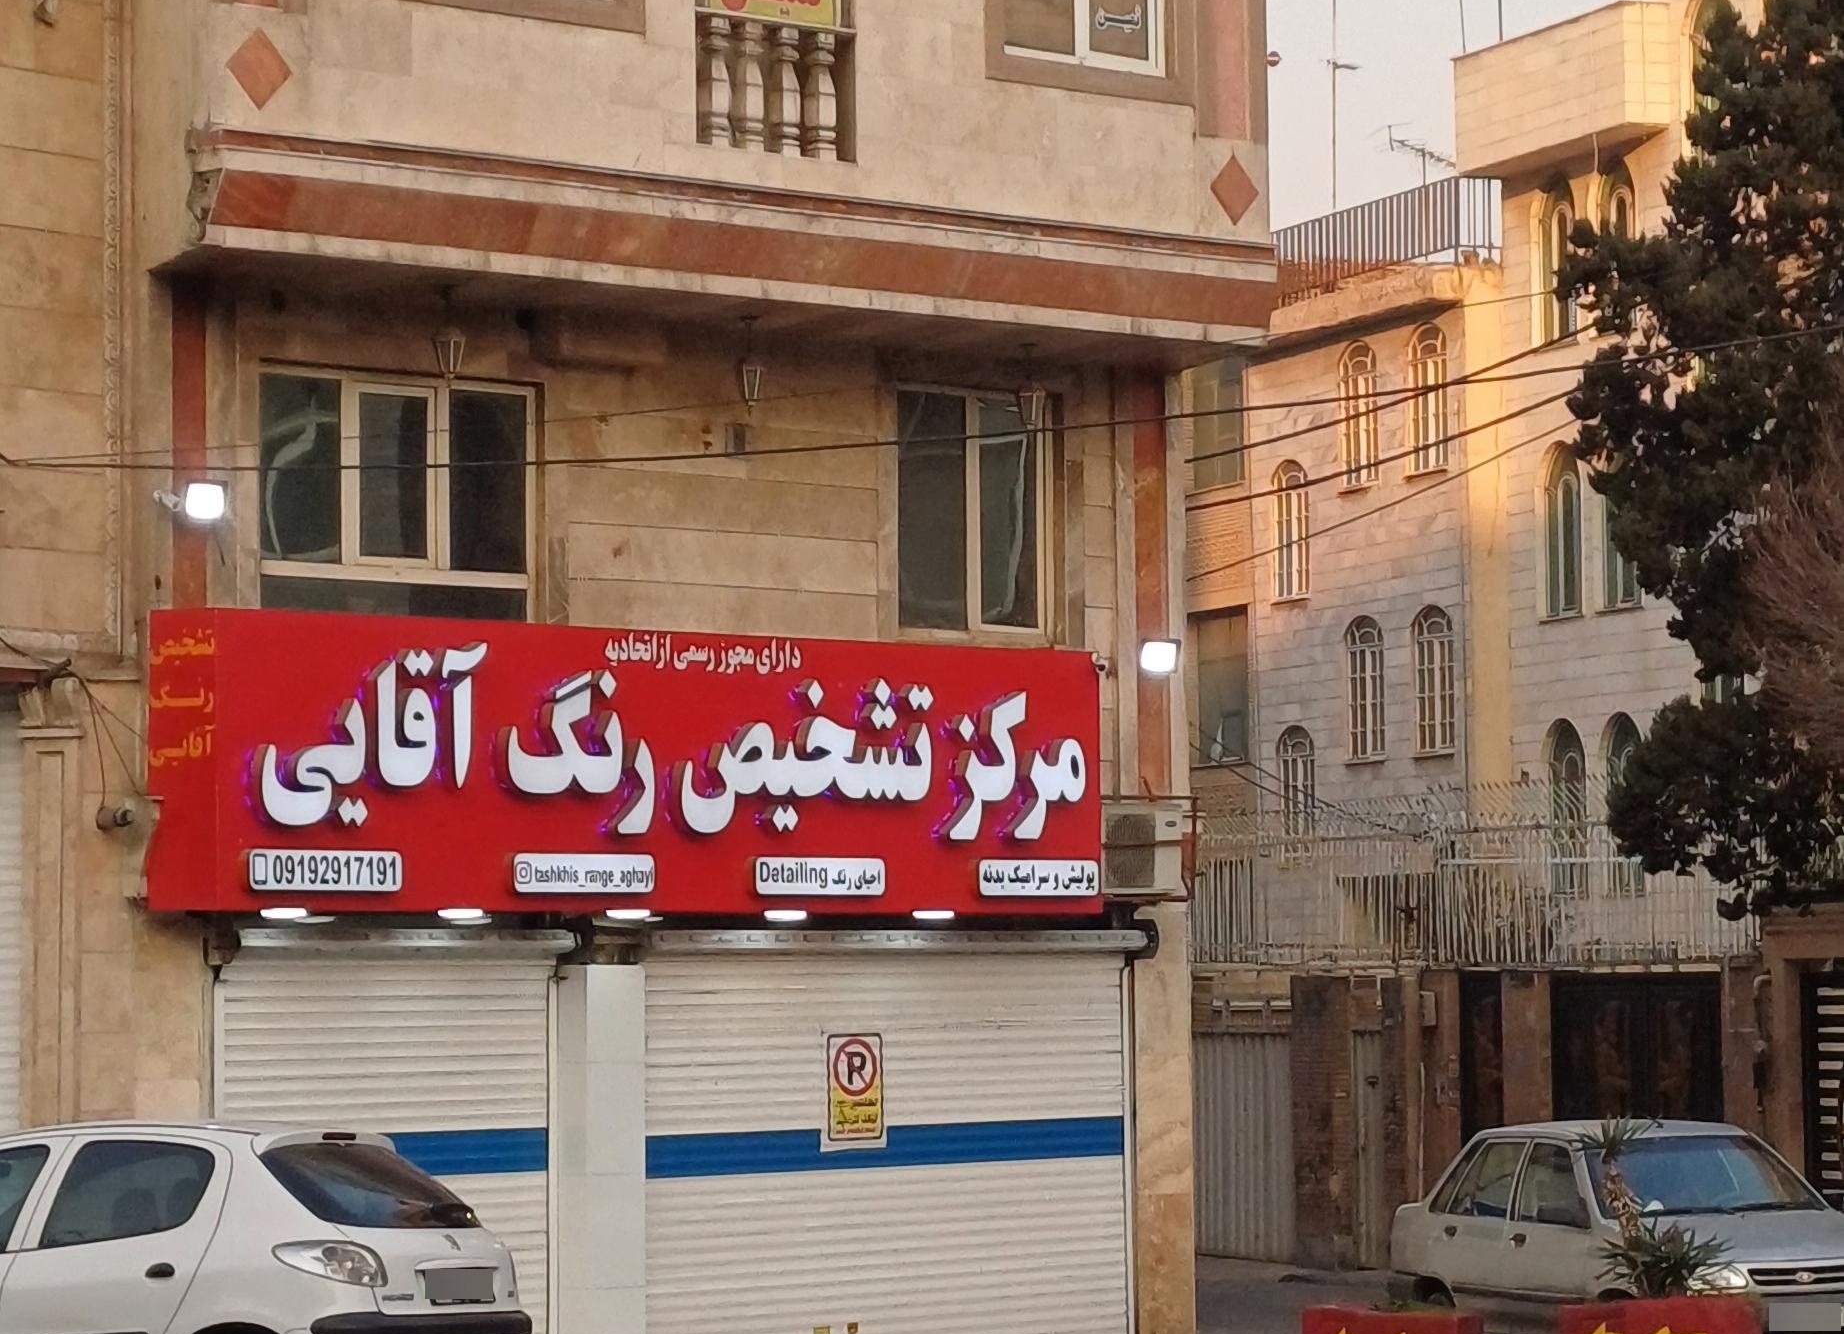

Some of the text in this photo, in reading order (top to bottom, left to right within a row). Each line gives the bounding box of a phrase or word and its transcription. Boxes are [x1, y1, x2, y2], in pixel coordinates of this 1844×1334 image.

[150, 628, 216, 666] تشخیص
[673, 644, 715, 672] رسمی
[717, 641, 755, 675] مجوز
[756, 638, 801, 675] دارای
[257, 641, 1086, 841] مرکز تشخیص رنگ آقایی
[272, 855, 398, 887] 09192917191
[759, 861, 828, 889] Detailing
[982, 864, 1096, 892] پولیش و سرامیک بدنه
